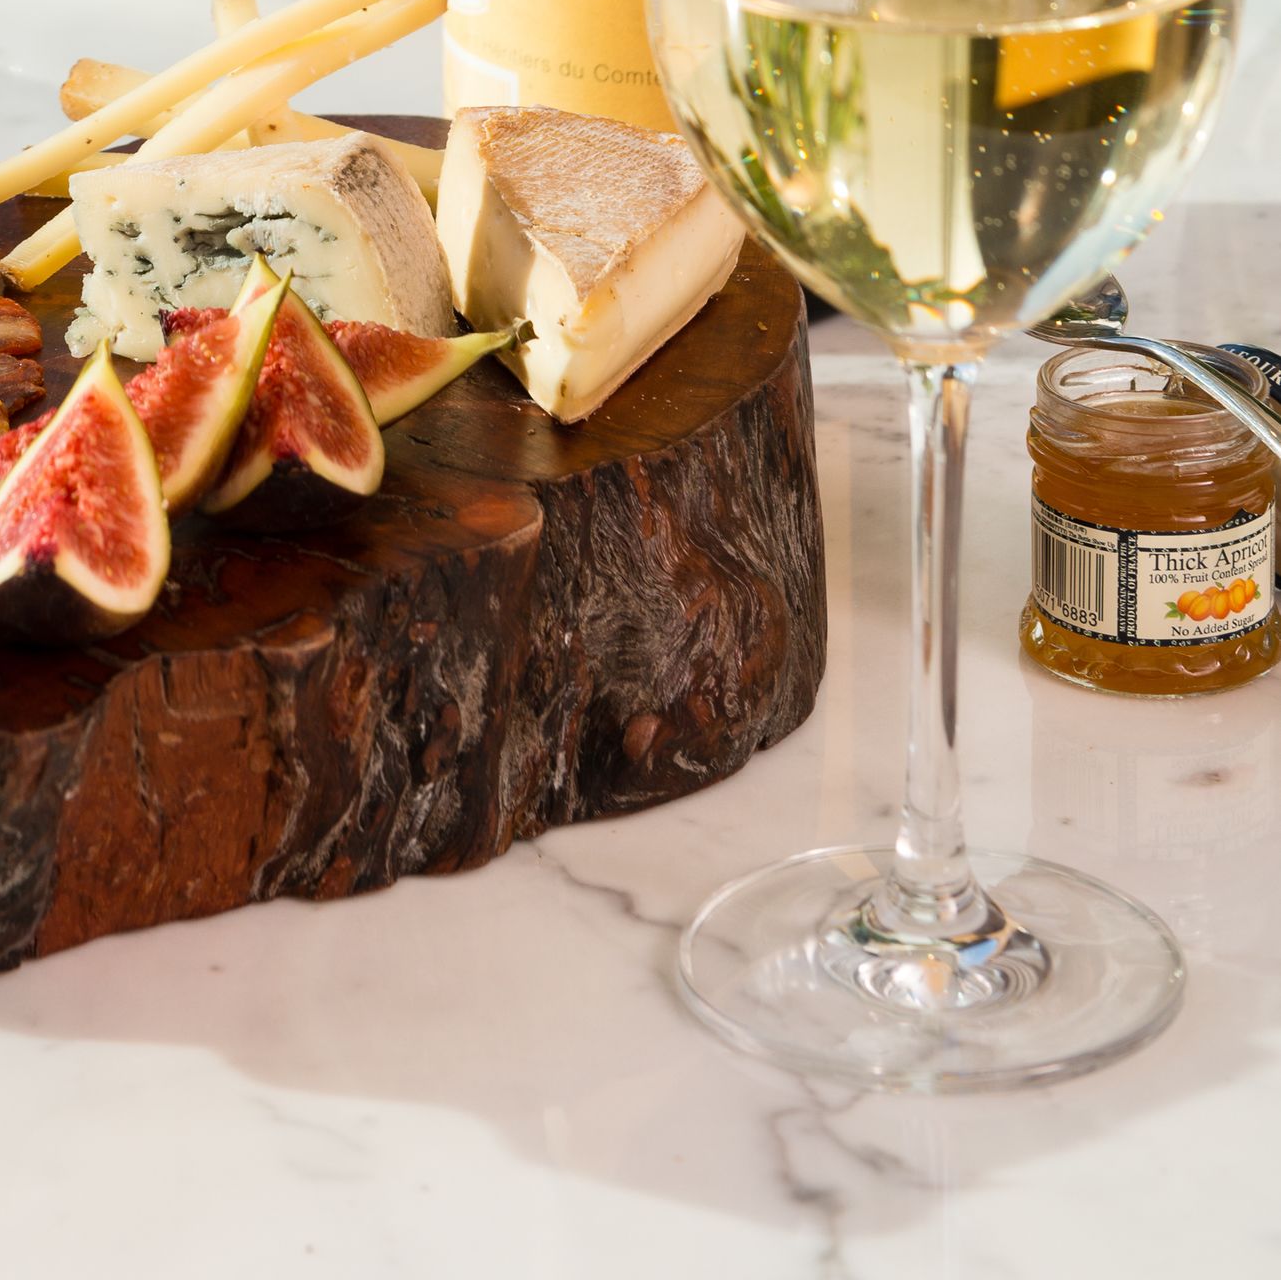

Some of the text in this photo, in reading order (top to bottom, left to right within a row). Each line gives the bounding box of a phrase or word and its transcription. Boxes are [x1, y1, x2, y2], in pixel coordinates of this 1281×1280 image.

[558, 59, 585, 79] du
[1149, 535, 1268, 571] Thick Apricot
[1149, 552, 1268, 584] 100% Fruit Content Spread
[1127, 536, 1137, 638] PRODUCT OF FRANCE
[1062, 603, 1098, 627] 6883
[1171, 613, 1255, 637] No Added Sugar
